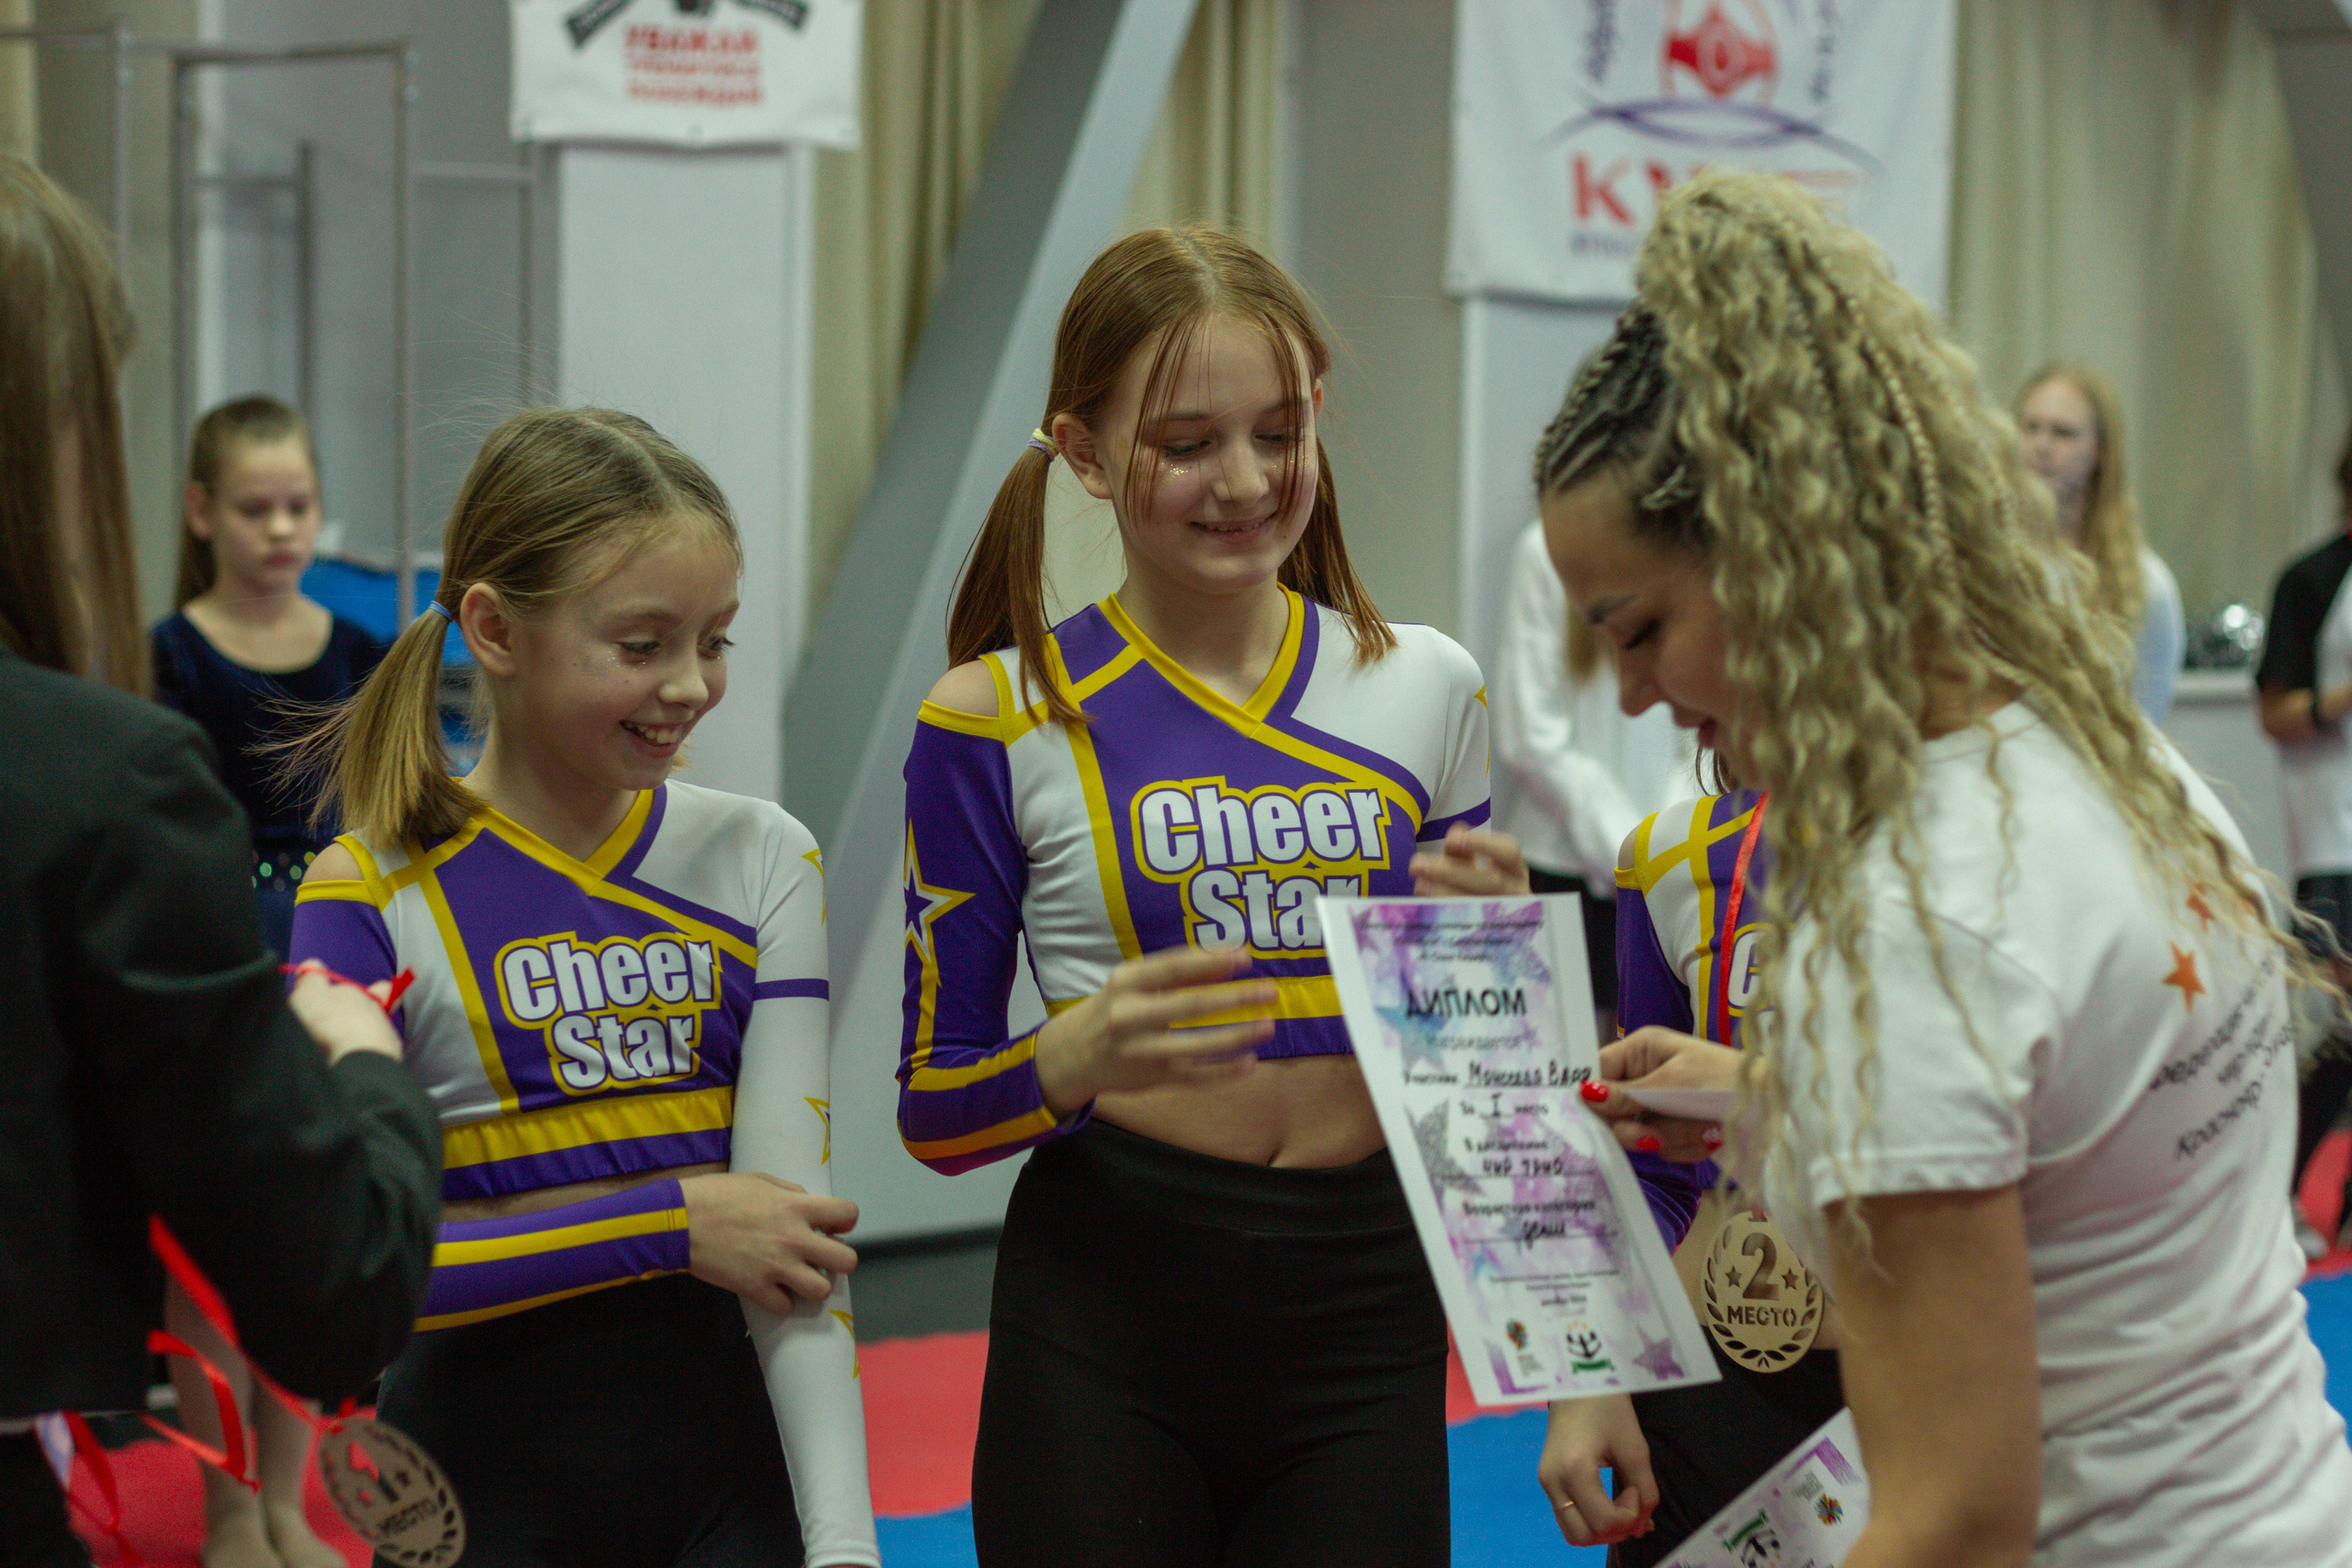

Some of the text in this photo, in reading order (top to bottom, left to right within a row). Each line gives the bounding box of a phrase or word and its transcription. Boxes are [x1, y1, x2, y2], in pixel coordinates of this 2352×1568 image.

[1139, 784, 1385, 873] Cheer
[503, 939, 715, 1021] Cheer
[1406, 987, 1527, 1019] ДИПЛОМ
[552, 1013, 695, 1089] Star
[1741, 1231, 1781, 1302] 2
[1726, 1305, 1798, 1327] МЕСТО
